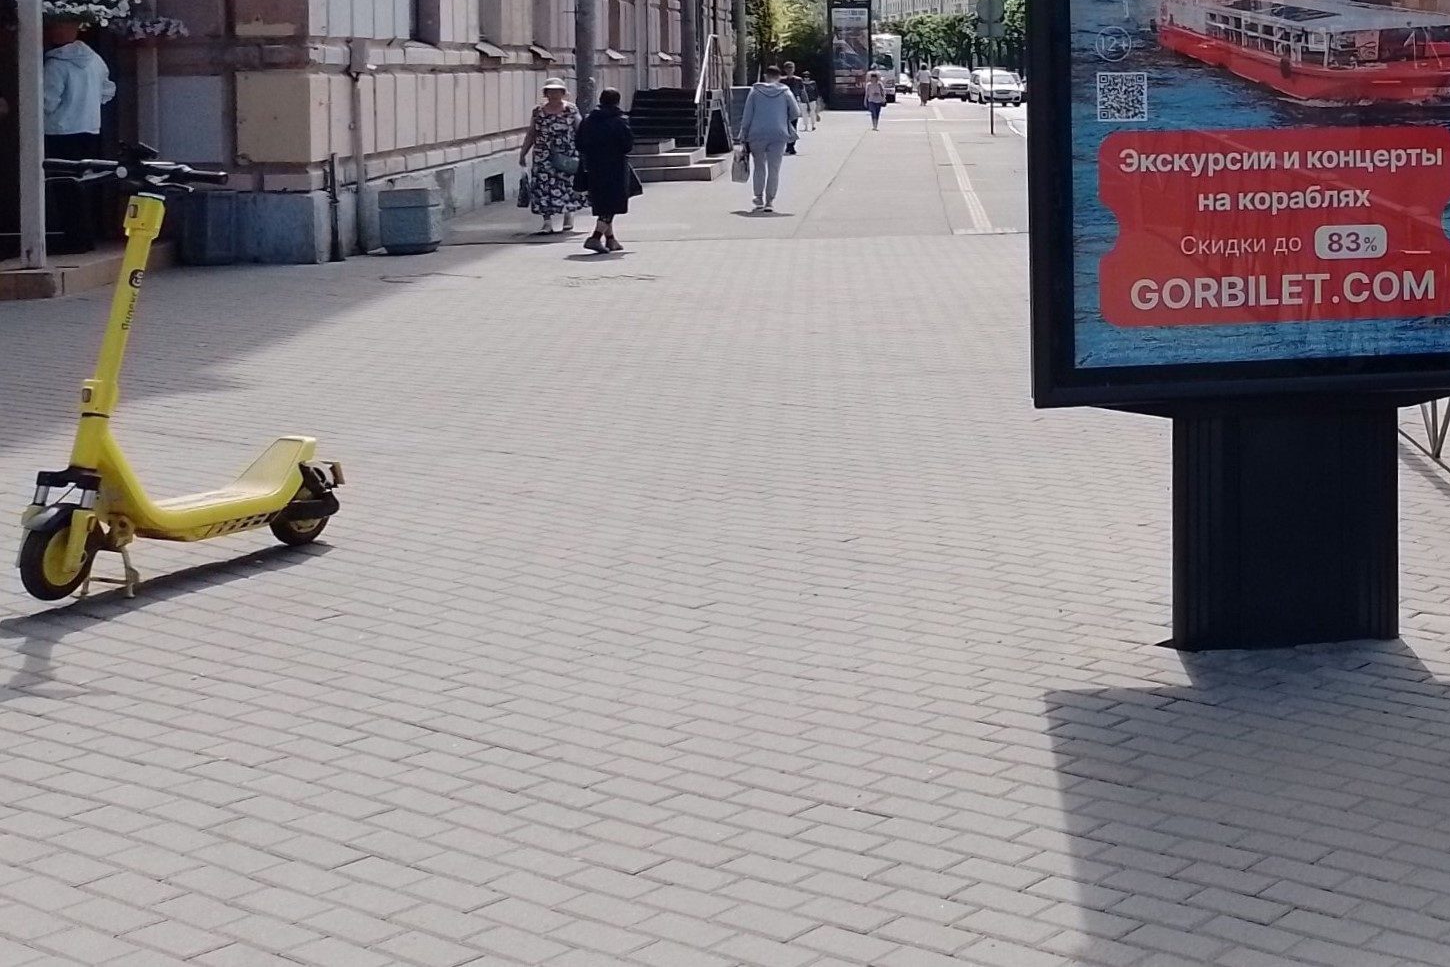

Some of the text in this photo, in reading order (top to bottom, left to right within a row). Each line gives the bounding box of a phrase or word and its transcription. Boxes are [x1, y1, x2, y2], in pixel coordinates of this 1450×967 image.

[1099, 36, 1129, 52] 12+
[1119, 147, 1443, 177] Экскурсии и концерты
[1198, 185, 1372, 216] на кораблях
[1180, 231, 1378, 257] Скидки до 83%
[1130, 269, 1436, 311] GORBILET.COM
